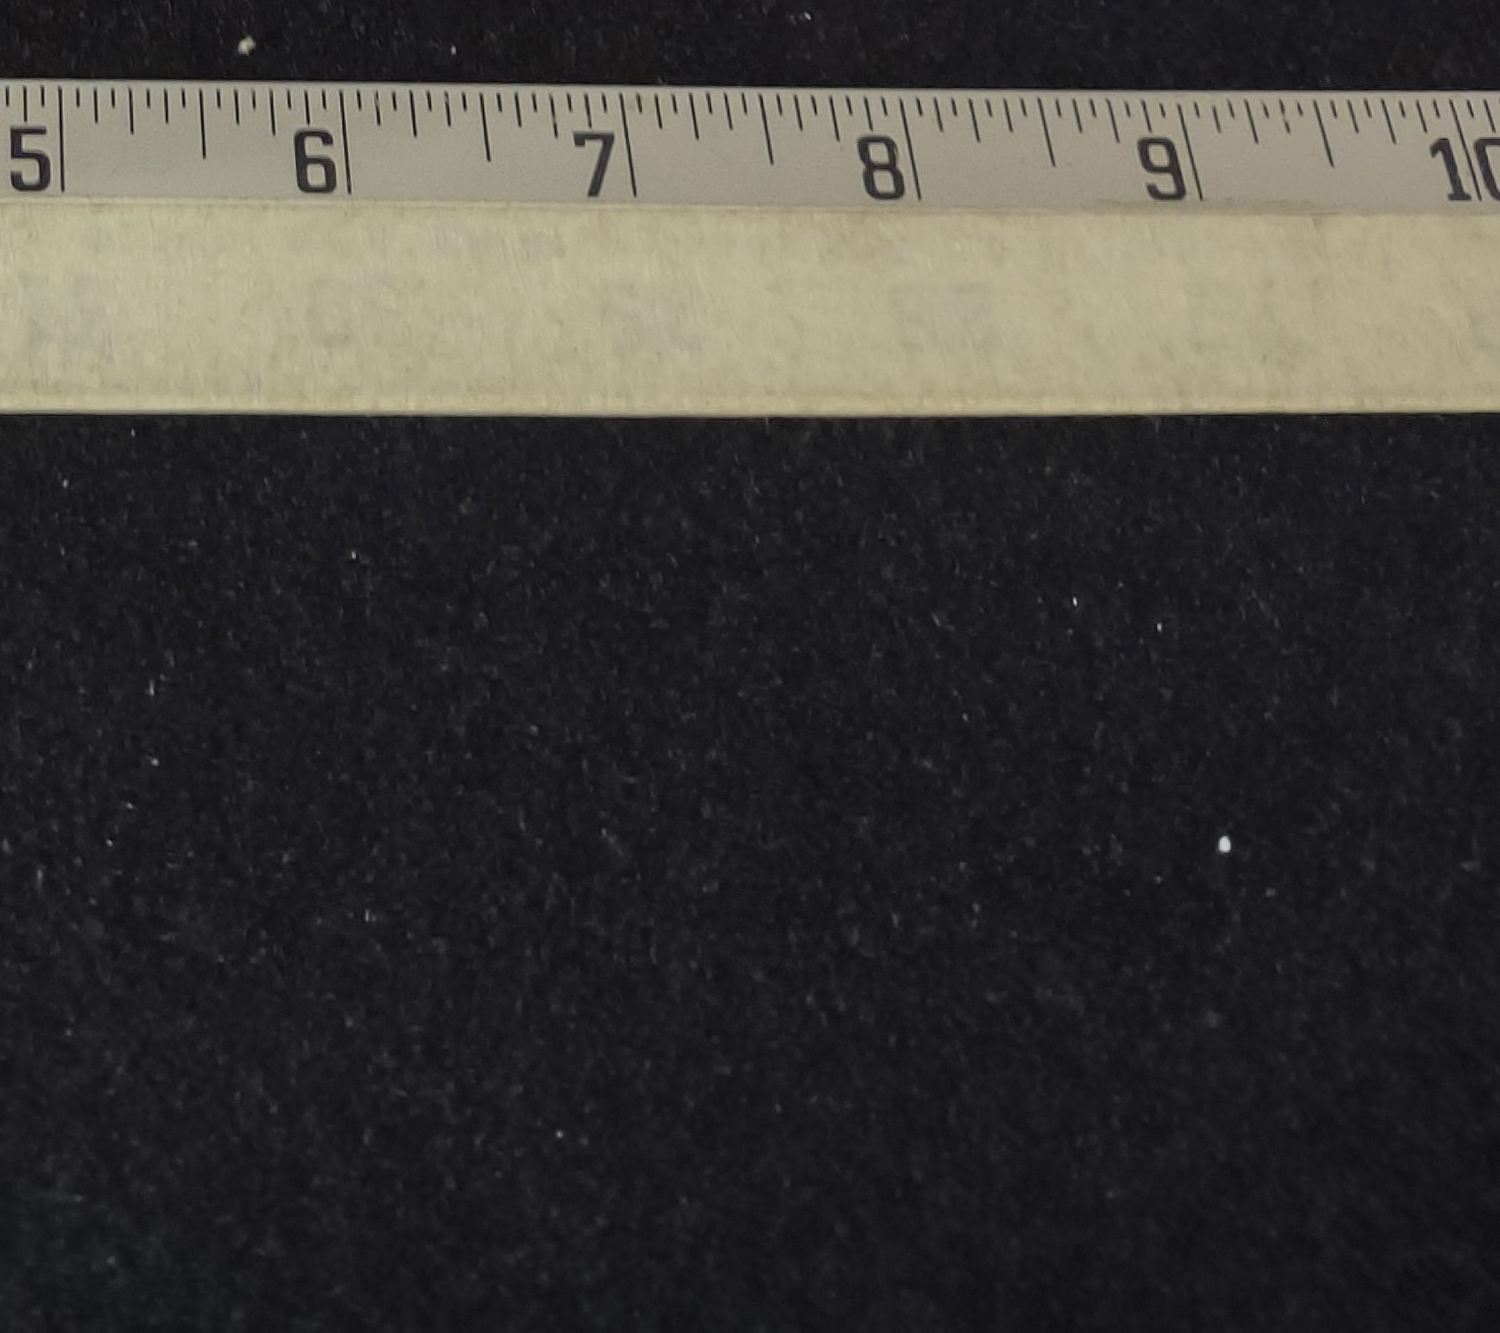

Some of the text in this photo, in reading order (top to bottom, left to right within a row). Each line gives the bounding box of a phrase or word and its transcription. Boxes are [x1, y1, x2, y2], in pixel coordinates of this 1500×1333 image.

[9, 126, 53, 192] 5
[293, 129, 337, 193] 6
[572, 132, 616, 197] 7
[858, 135, 905, 200] 8
[1138, 137, 1187, 201] 9
